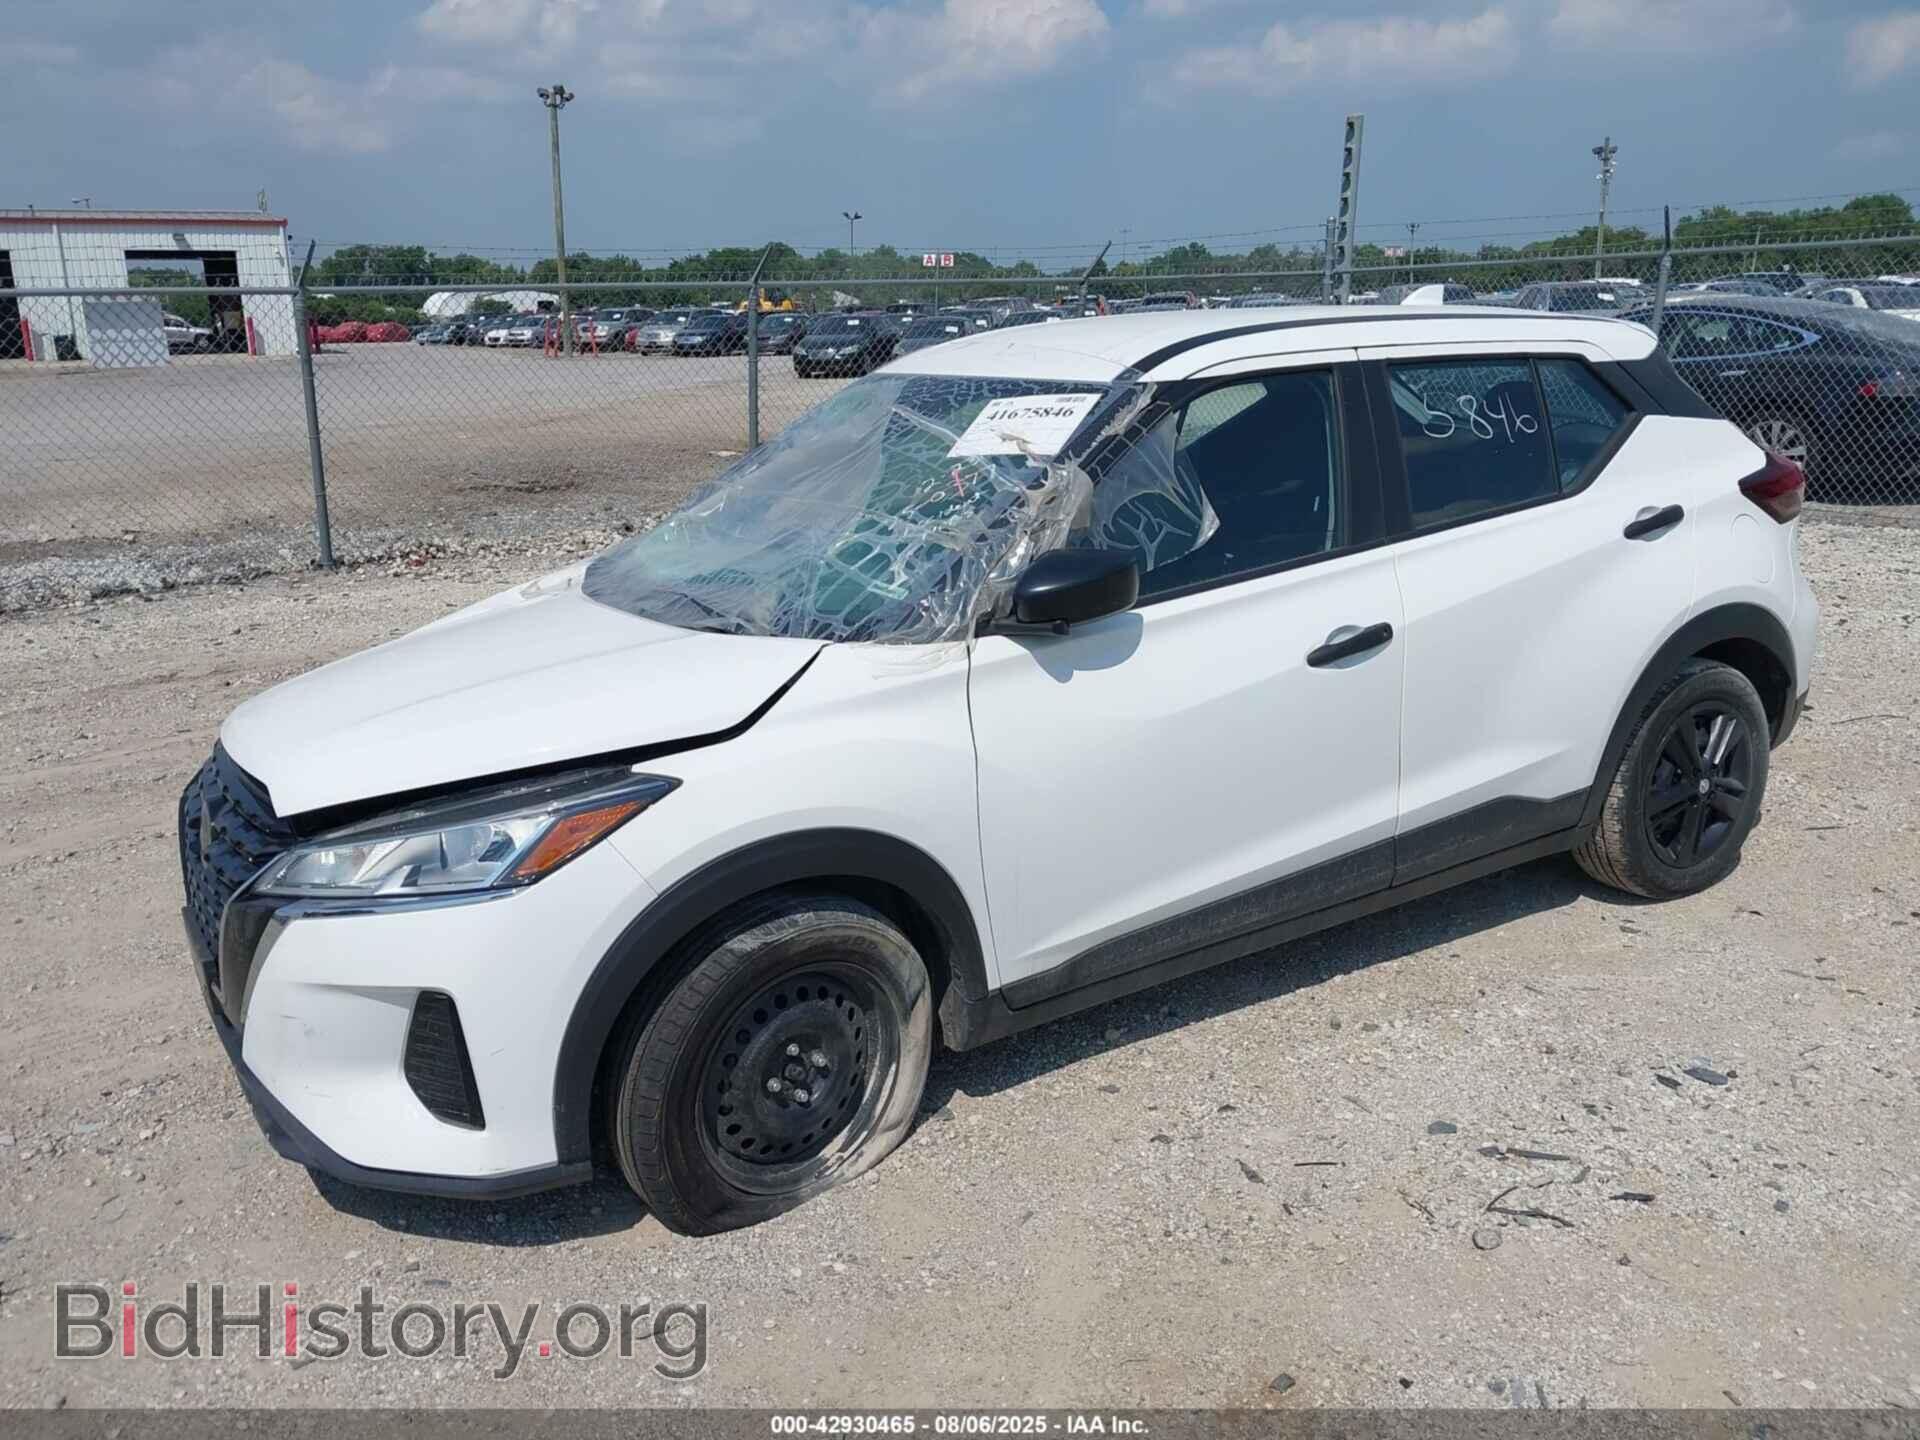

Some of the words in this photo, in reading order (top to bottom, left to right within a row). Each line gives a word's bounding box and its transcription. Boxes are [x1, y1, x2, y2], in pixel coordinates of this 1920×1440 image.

[925, 255, 934, 266] A
[943, 255, 953, 266] B
[986, 406, 1075, 420] 41675846
[1422, 392, 1538, 443] 5846
